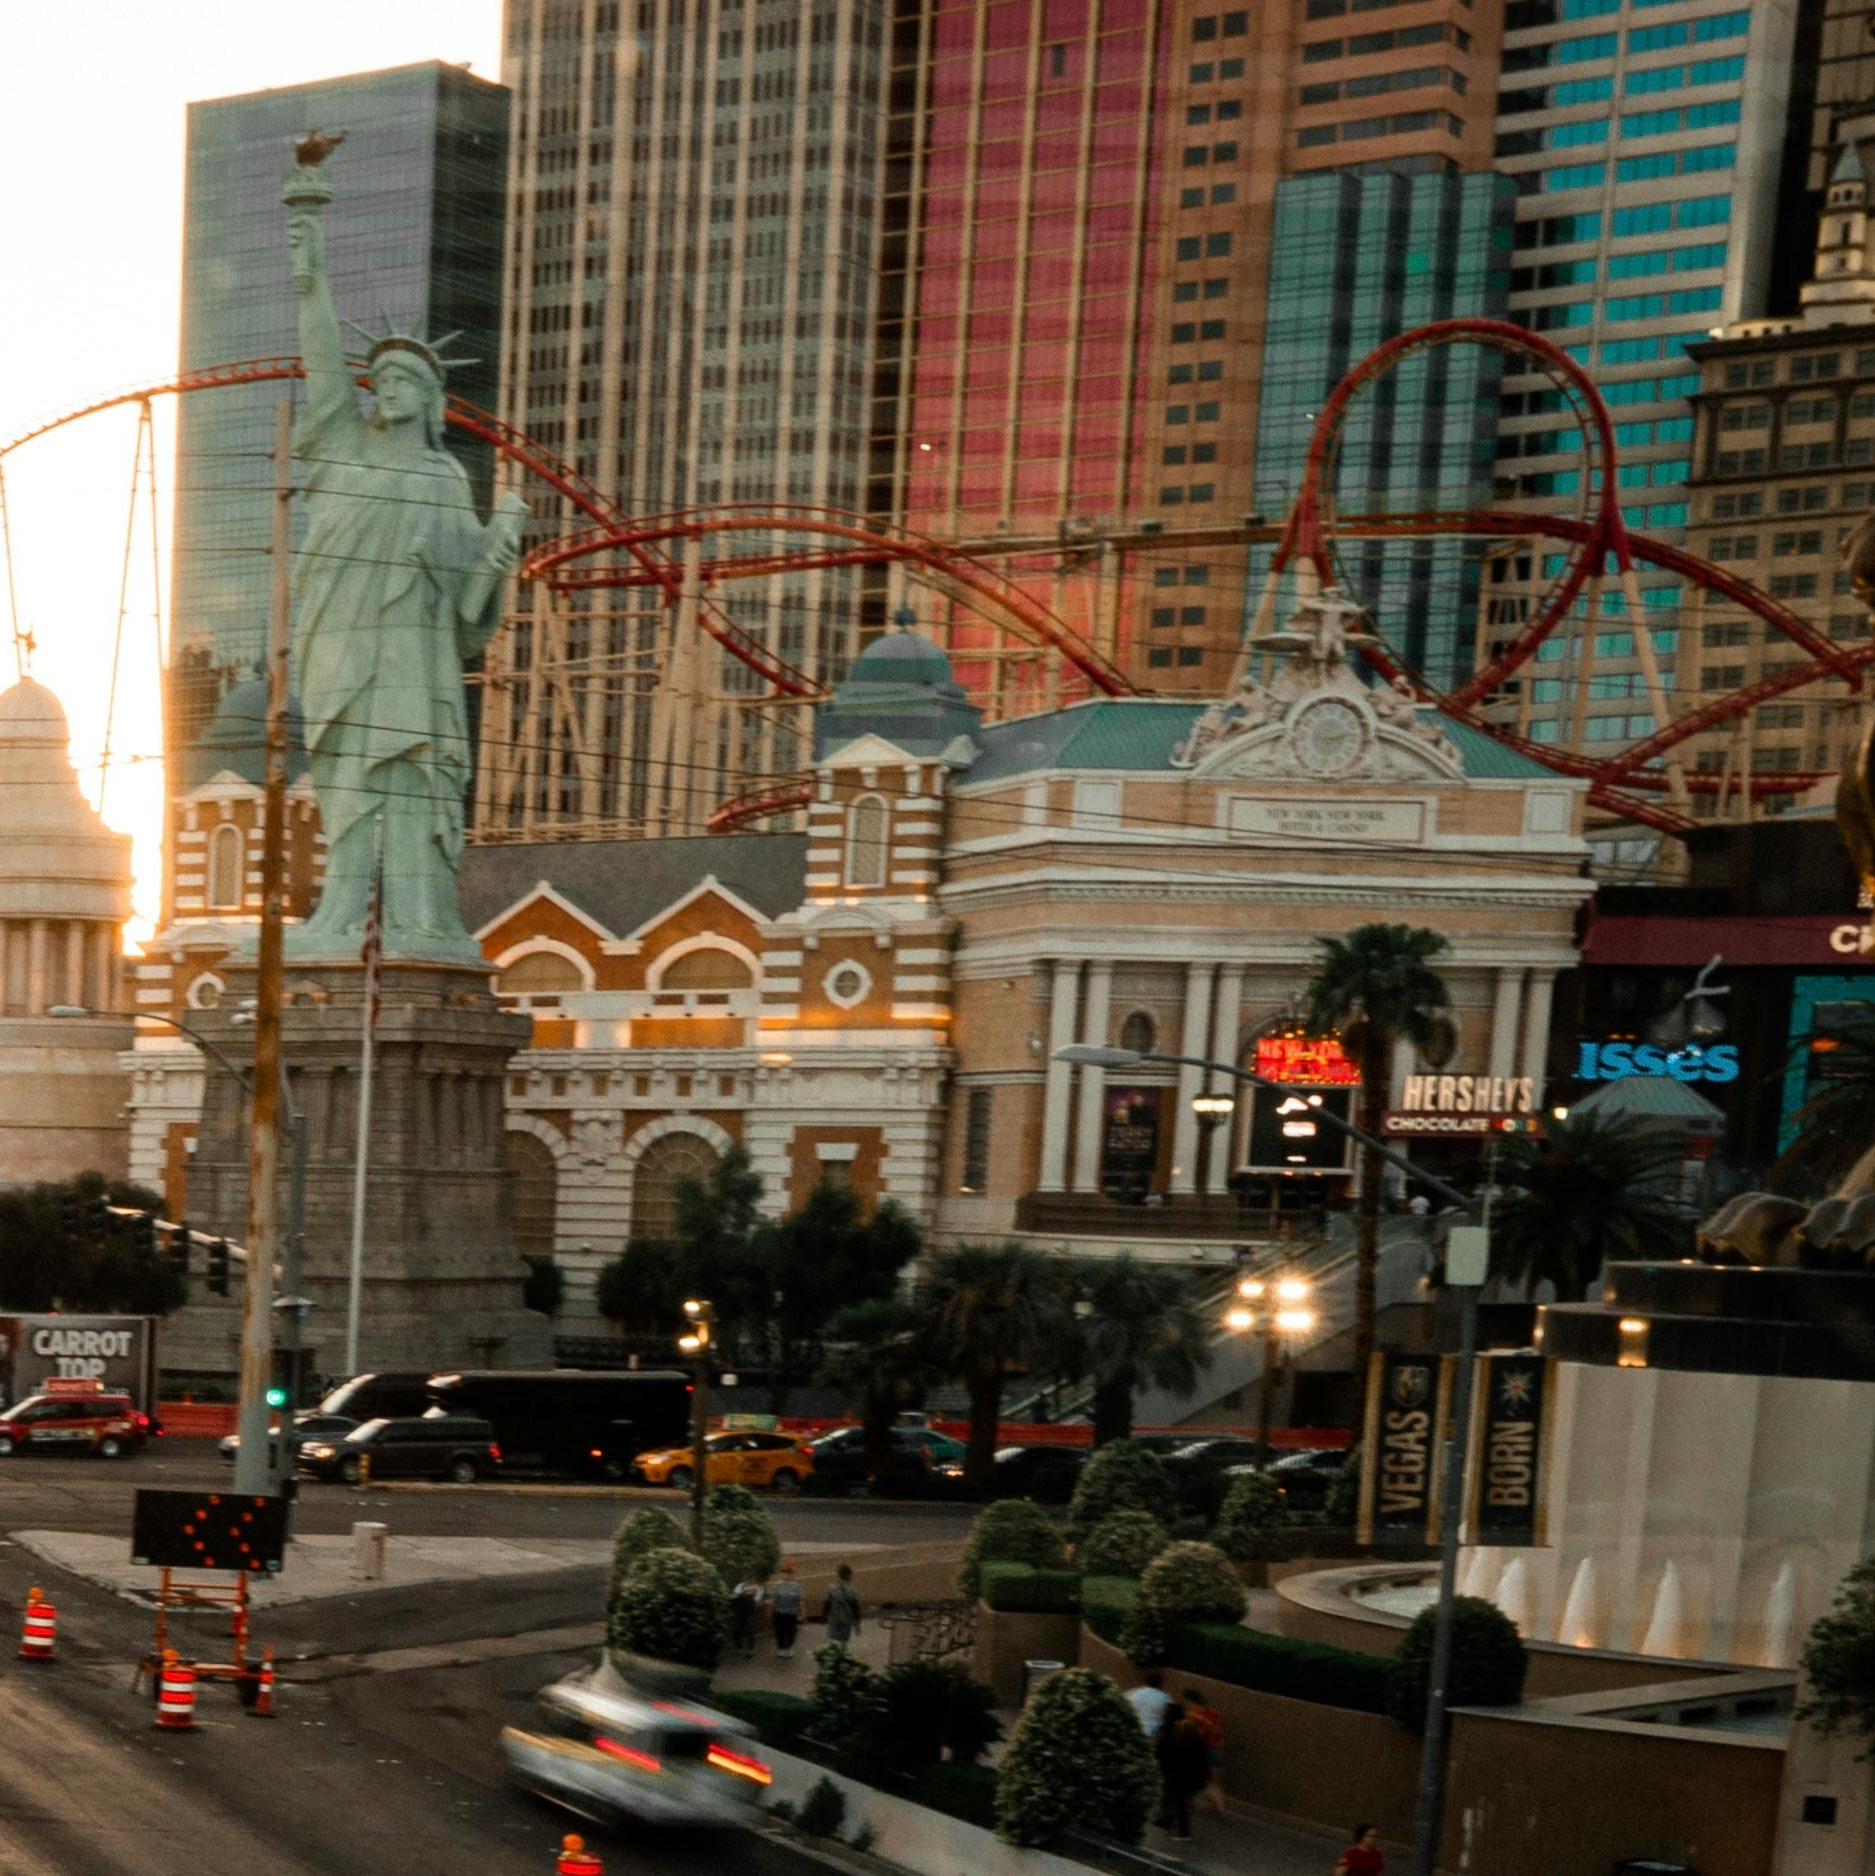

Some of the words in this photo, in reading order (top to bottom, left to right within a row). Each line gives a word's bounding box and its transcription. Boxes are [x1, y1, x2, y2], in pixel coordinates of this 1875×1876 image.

[1386, 1117, 1490, 1132] CHOCOLATE
[33, 1328, 133, 1358] CARROT
[54, 1356, 106, 1379] TOP
[1380, 1411, 1431, 1513] VEGAS
[1488, 1421, 1535, 1506] BORN
